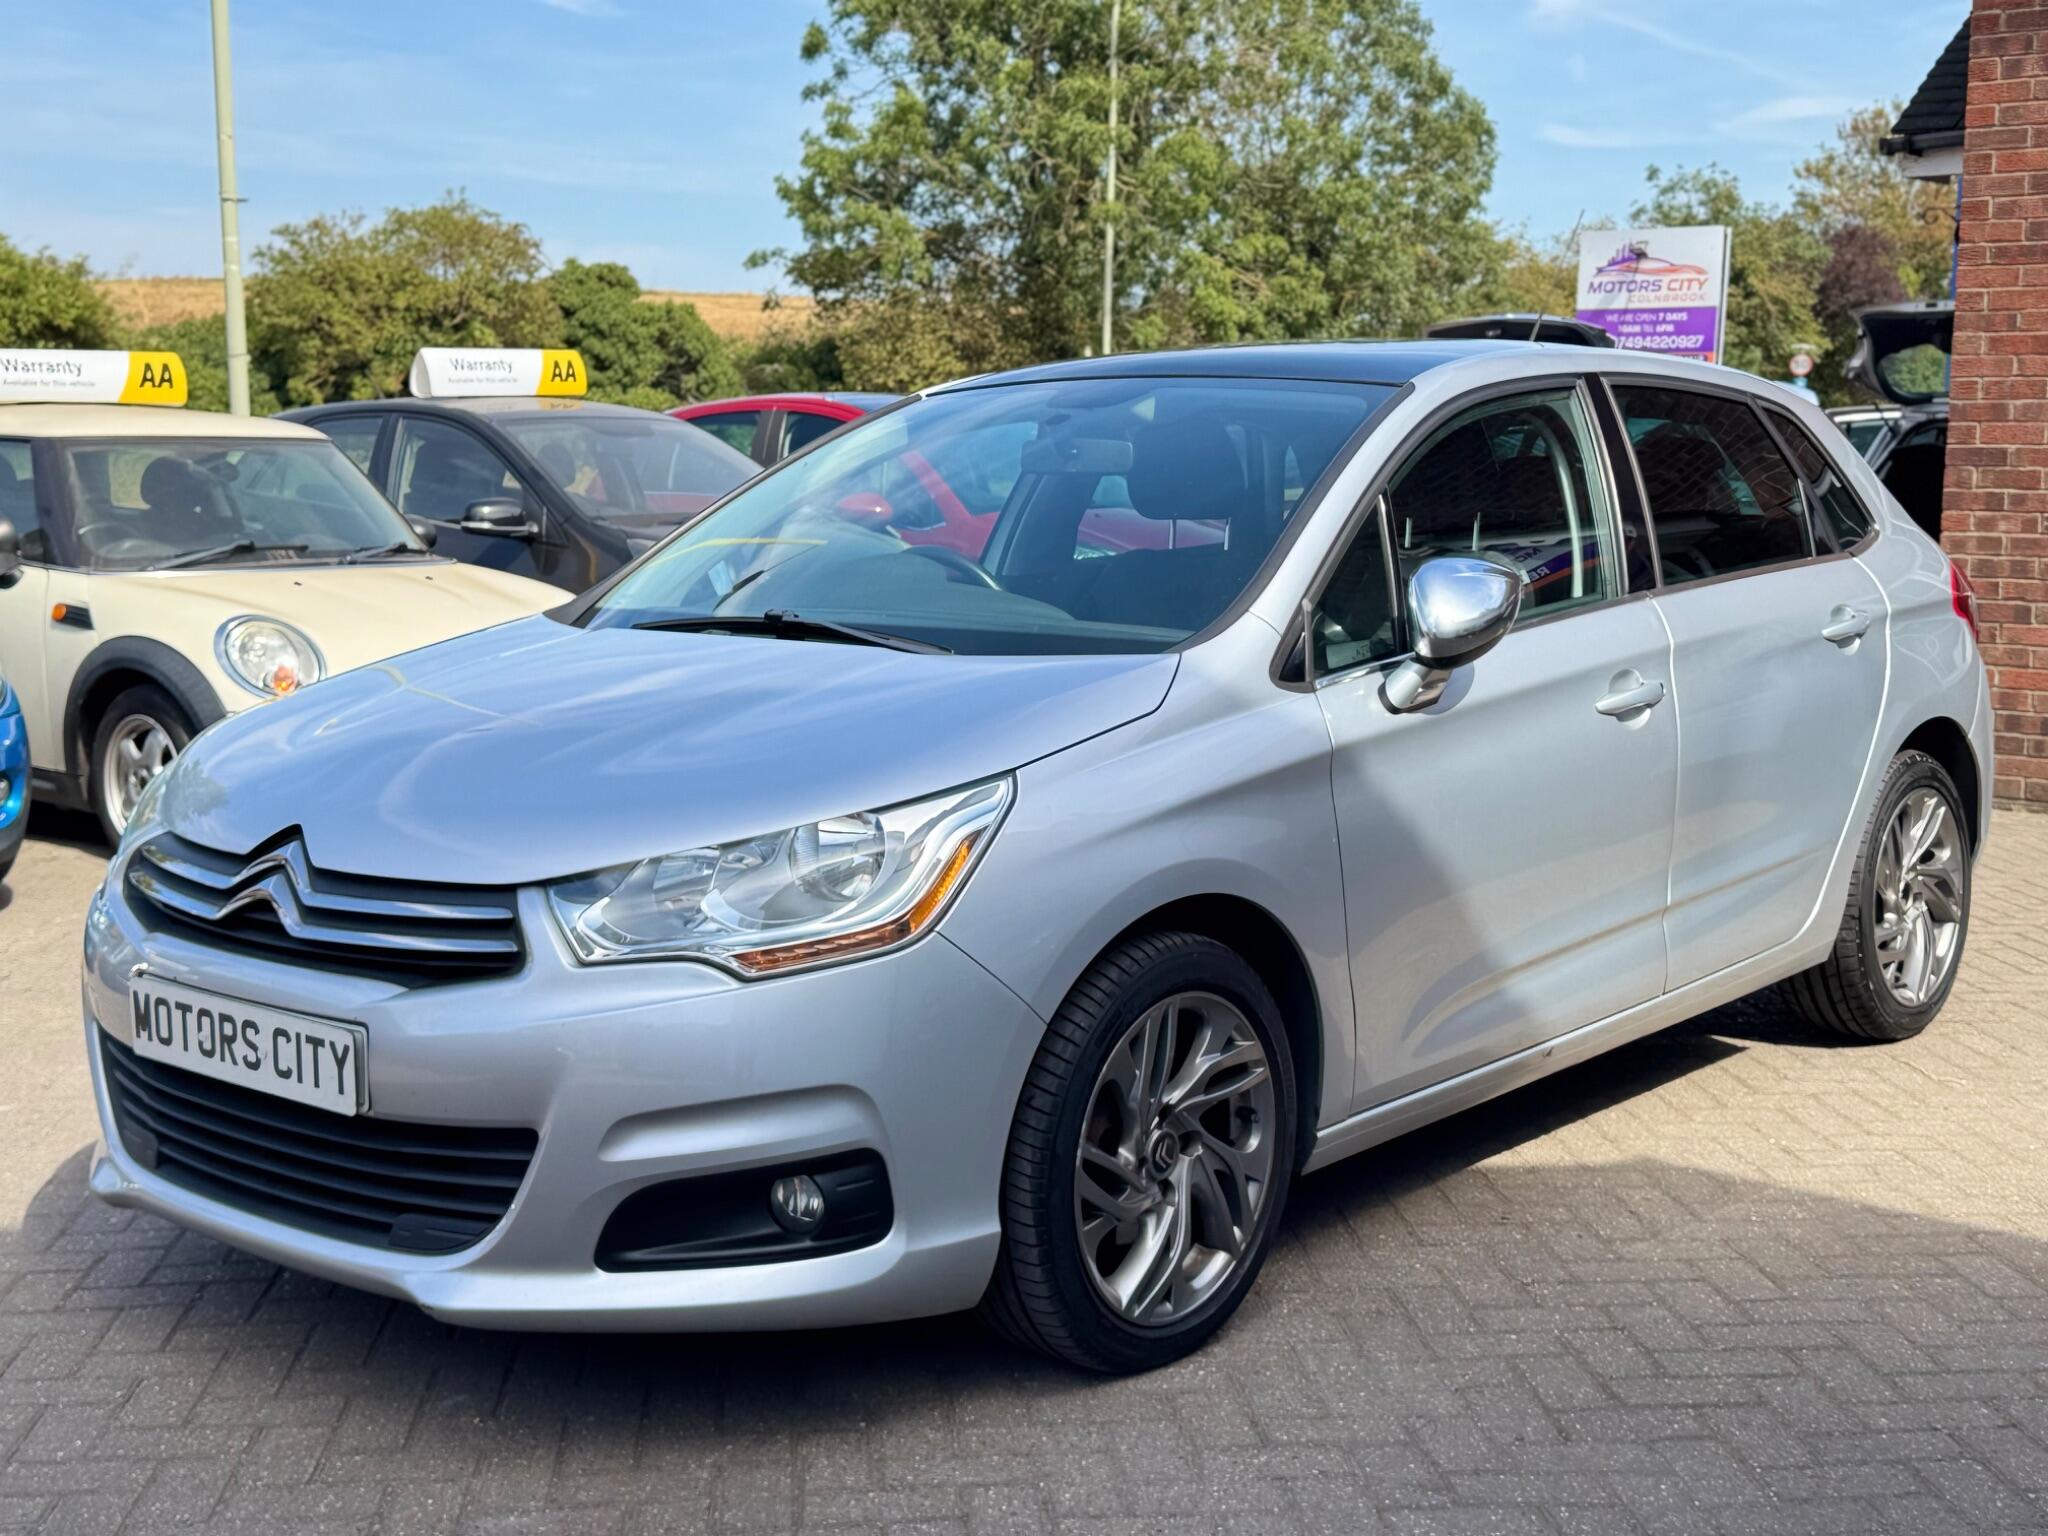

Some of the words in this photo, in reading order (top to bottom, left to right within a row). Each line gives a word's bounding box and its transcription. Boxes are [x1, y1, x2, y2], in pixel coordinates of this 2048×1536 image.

[1587, 279, 1662, 294] MOTORS
[1666, 278, 1708, 292] CITY
[0, 358, 82, 377] Warranty
[139, 362, 174, 389] AA
[449, 358, 513, 374] Warranty
[550, 360, 577, 382] AA
[133, 990, 262, 1071] MOTORS
[272, 1027, 350, 1095] CITY
